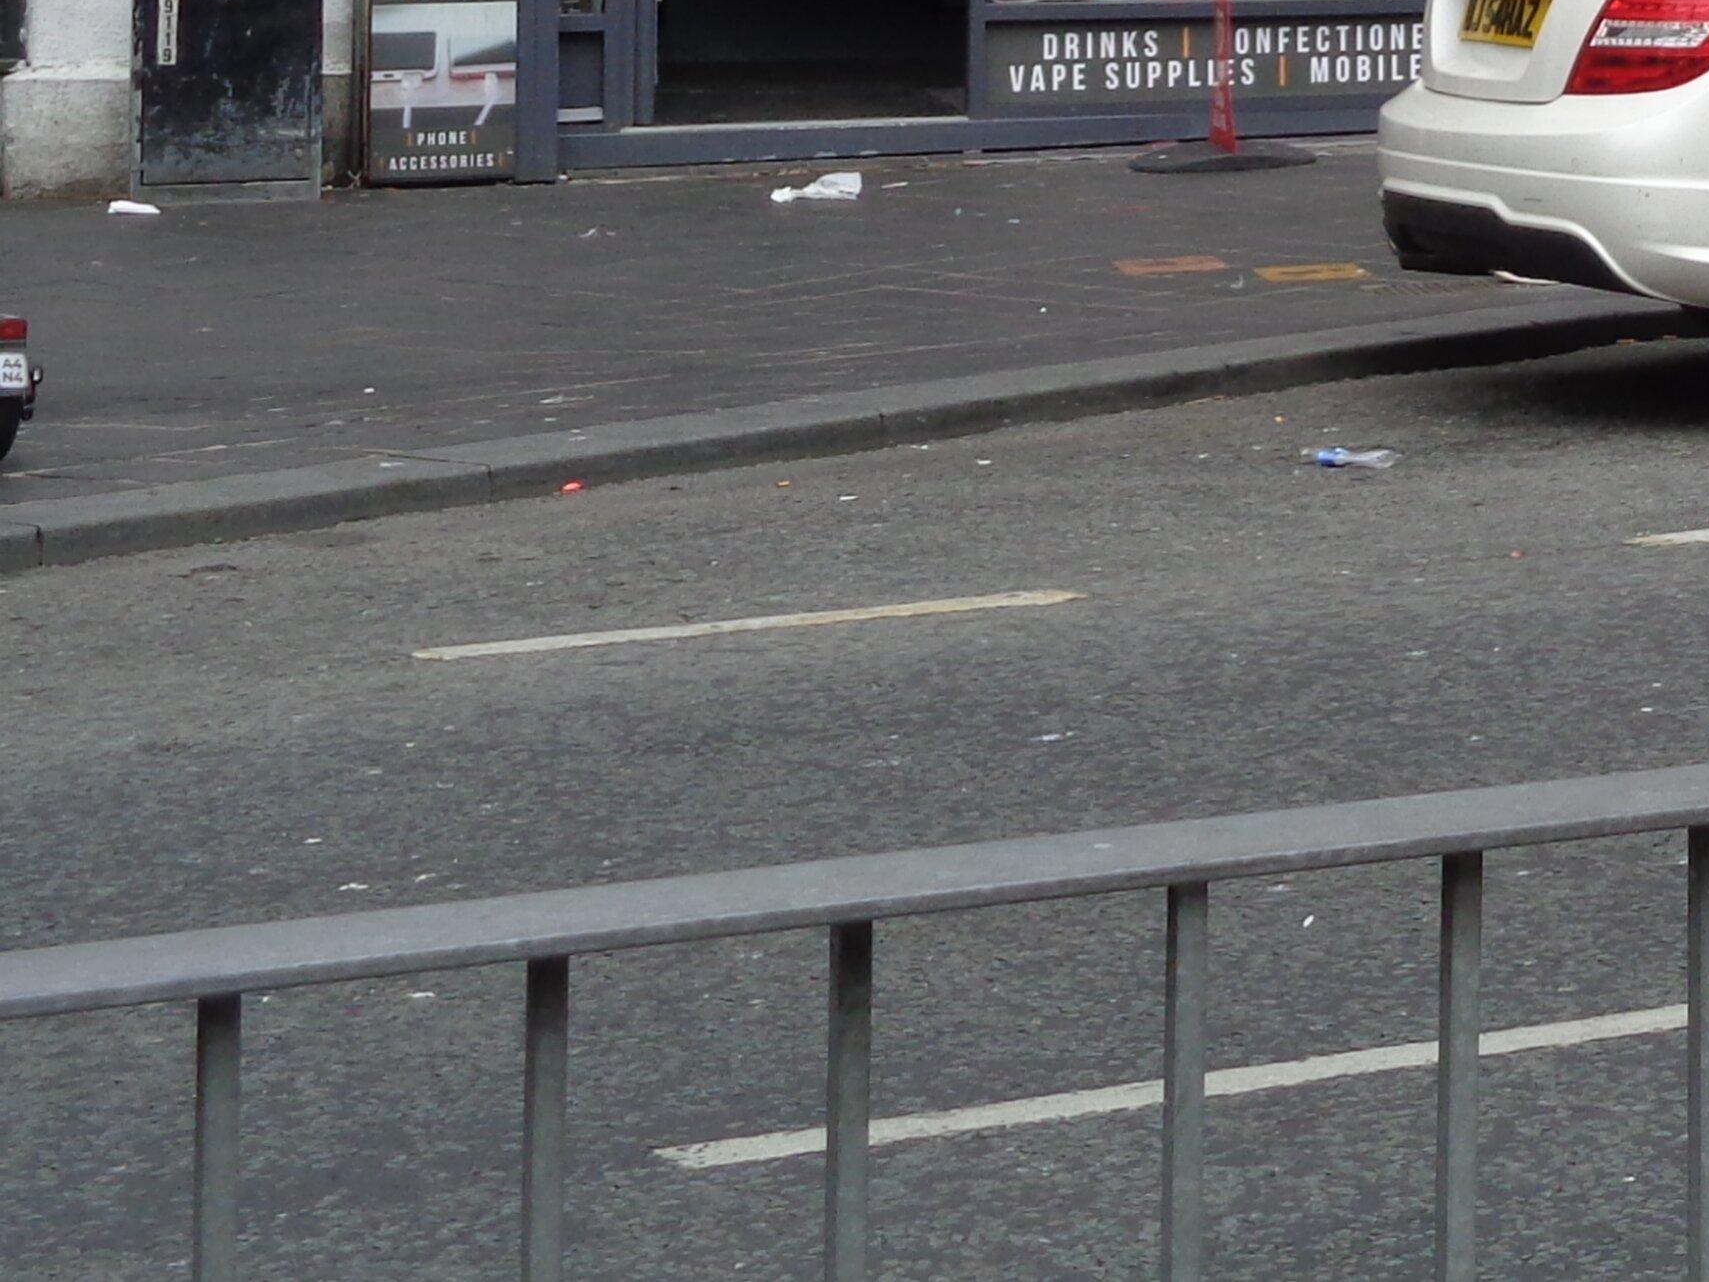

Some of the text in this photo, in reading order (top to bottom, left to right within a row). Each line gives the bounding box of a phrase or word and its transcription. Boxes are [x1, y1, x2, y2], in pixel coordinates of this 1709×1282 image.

[1042, 23, 1424, 60] DRINKS ONFECTIONE
[1009, 63, 1087, 93] VAPE
[1310, 53, 1423, 85] MOBILE
[416, 130, 468, 146] PHONE
[388, 152, 496, 171] ACCESSORIES
